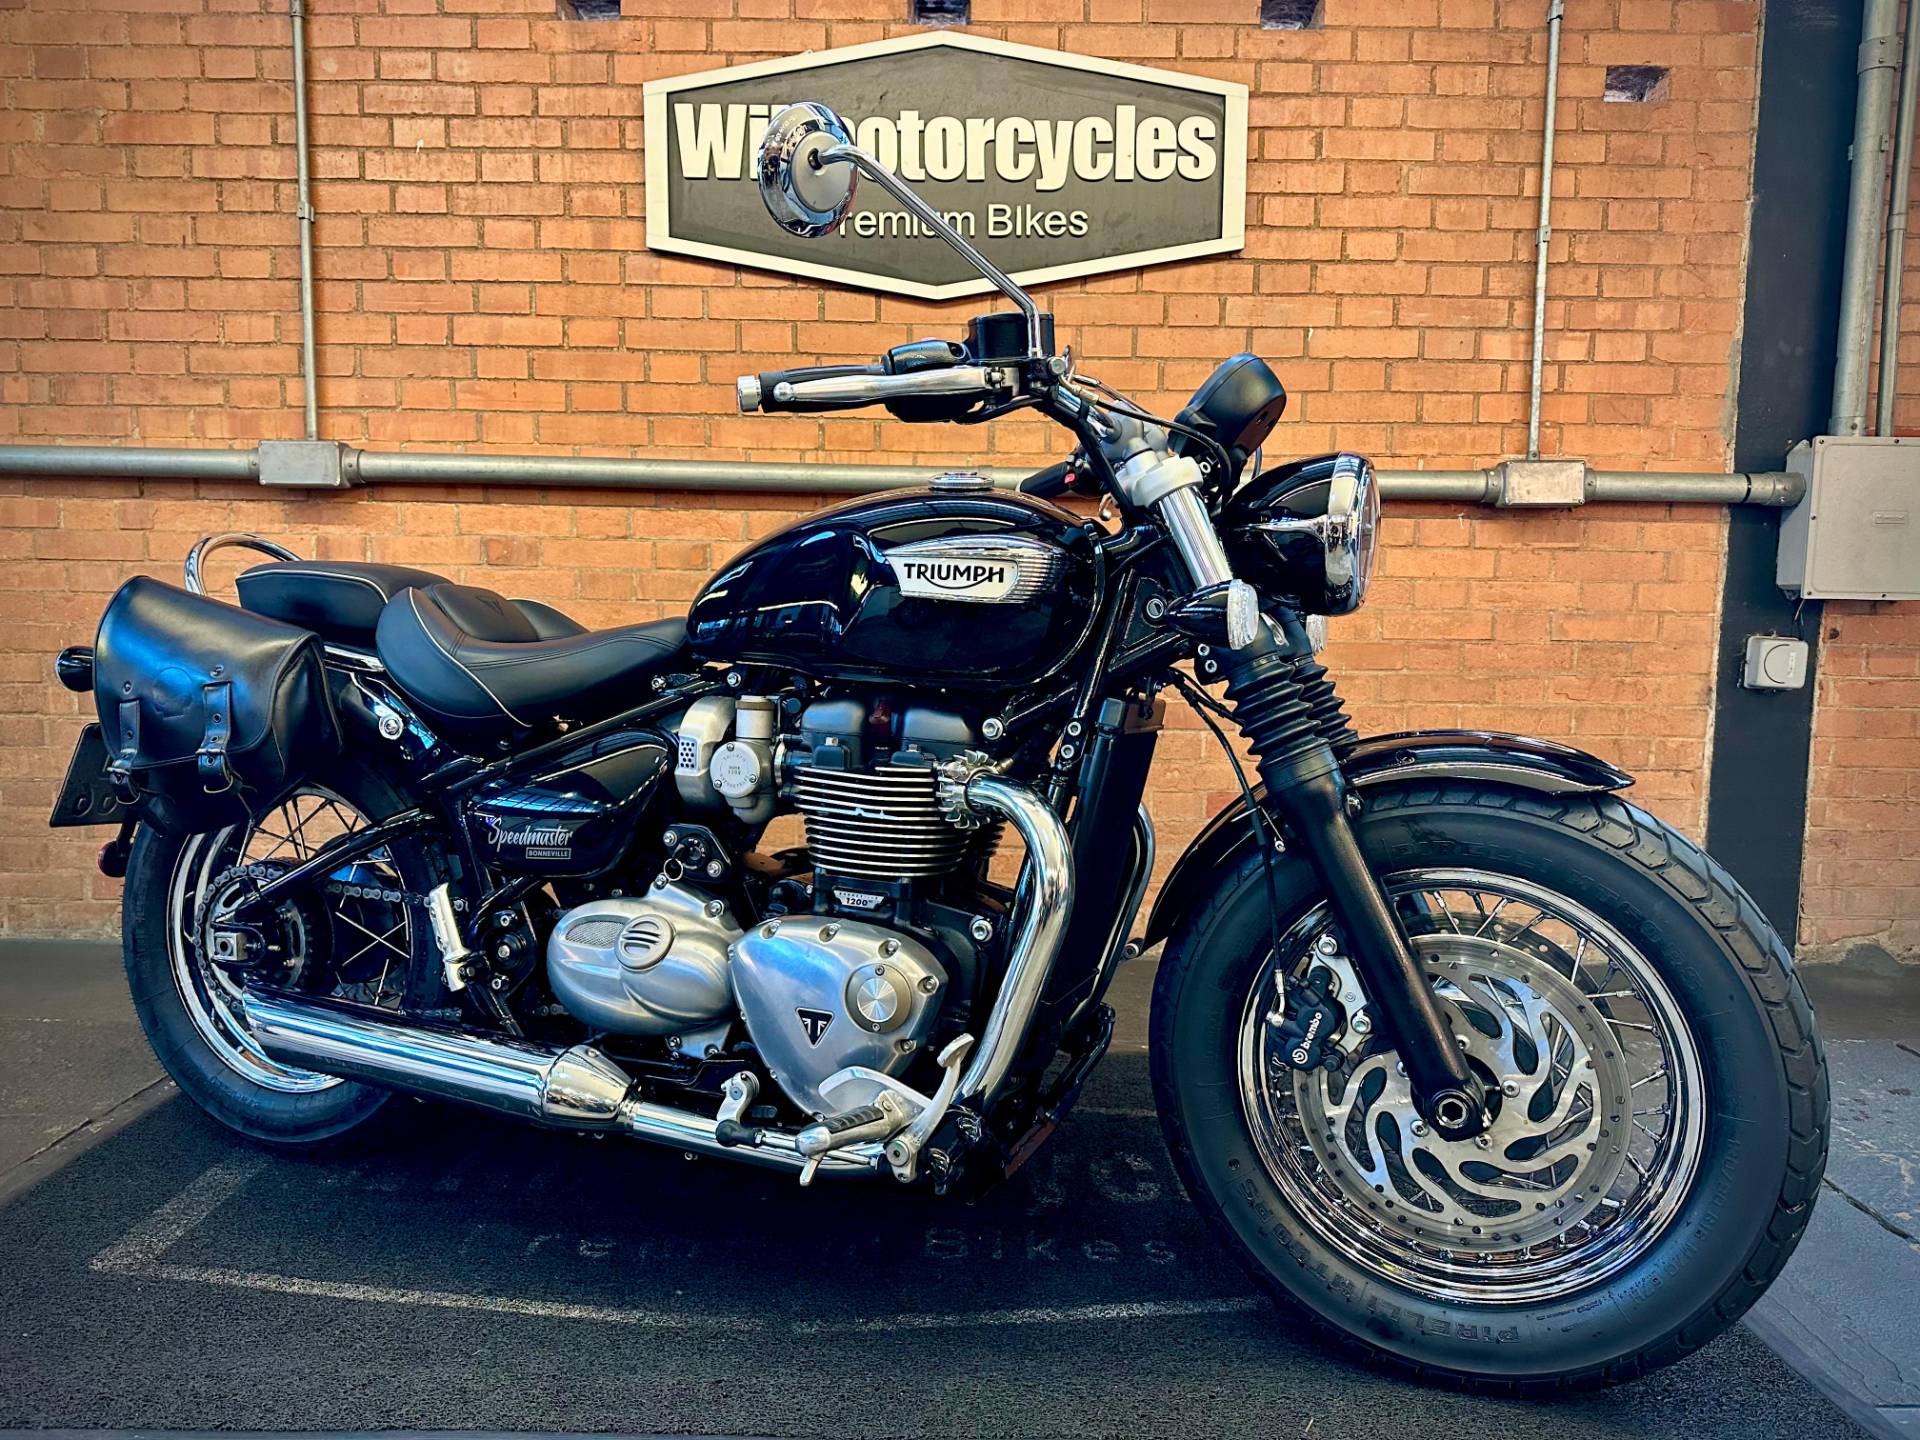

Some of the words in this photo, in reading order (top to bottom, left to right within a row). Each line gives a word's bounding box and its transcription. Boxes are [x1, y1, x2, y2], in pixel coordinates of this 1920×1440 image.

[673, 103, 1216, 192] Wiotorcycles
[838, 210, 975, 237] remim
[904, 563, 1004, 588] TRIUMPH
[488, 817, 574, 852] Speedmaster
[528, 849, 569, 857] BONNEVILLE
[845, 897, 868, 906] 1200
[1300, 1012, 1323, 1050] brembo
[1366, 1295, 1521, 1344] PIRELLI
